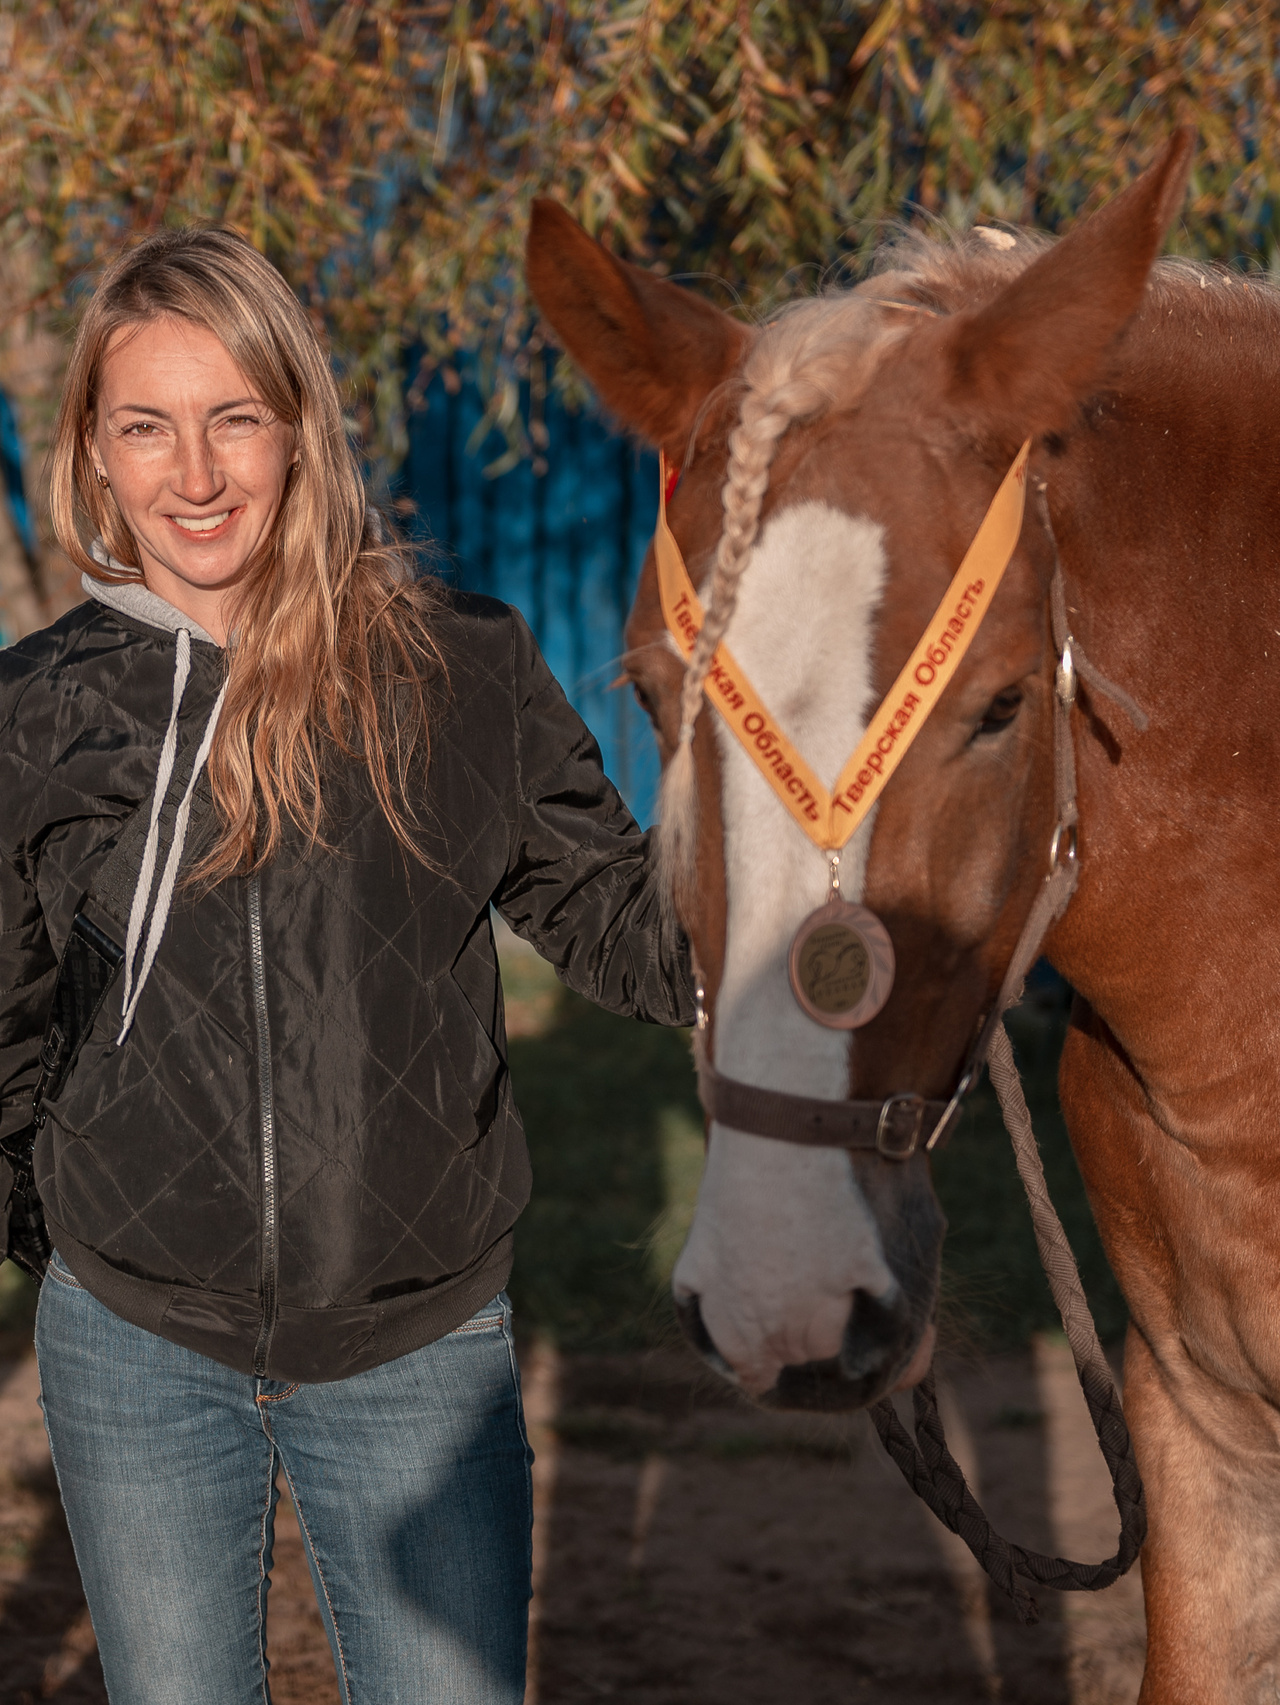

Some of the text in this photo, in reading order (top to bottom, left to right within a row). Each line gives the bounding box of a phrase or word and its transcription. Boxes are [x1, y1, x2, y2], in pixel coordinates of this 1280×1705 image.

[672, 591, 820, 822] Твекая Область
[831, 577, 986, 815] Тверская Область
